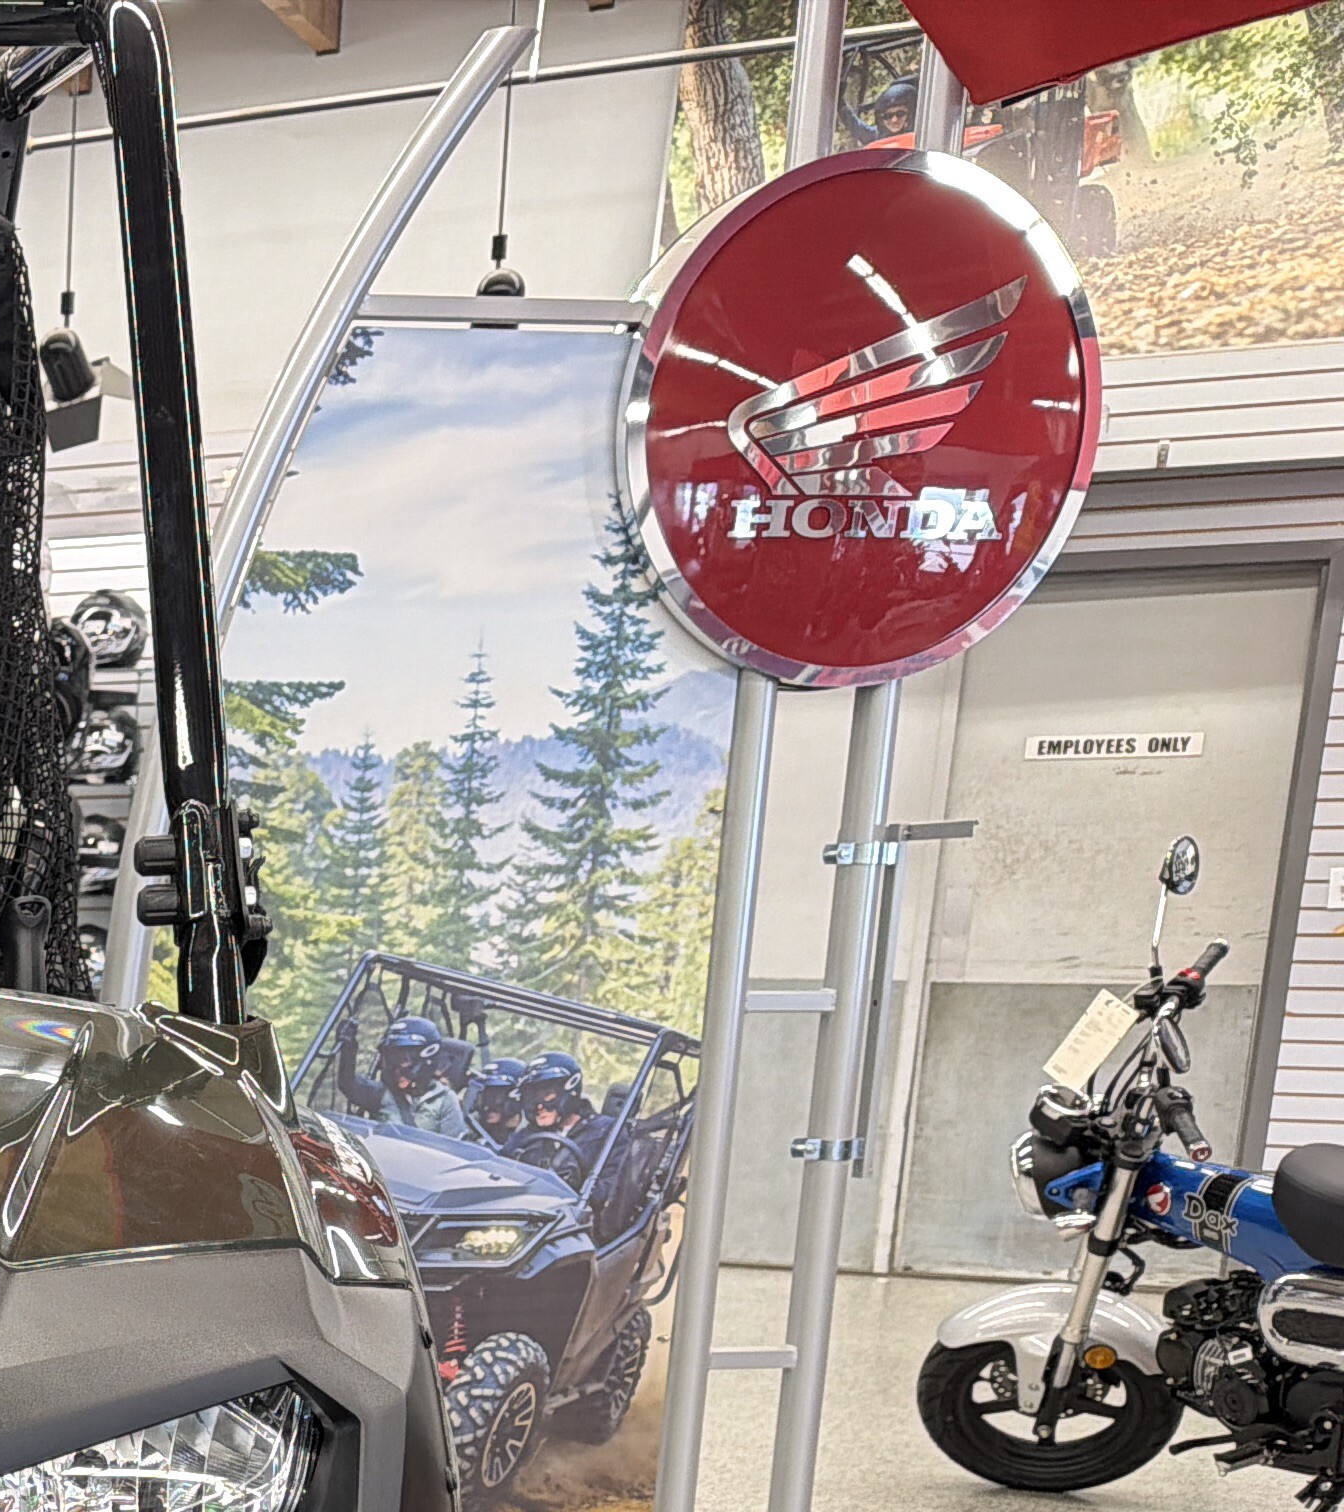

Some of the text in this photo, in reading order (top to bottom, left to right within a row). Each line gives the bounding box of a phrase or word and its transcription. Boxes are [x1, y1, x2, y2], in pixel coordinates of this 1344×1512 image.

[726, 497, 1004, 541] HONDA
[1036, 736, 1192, 756] EMPLOYEES ONLY
[1182, 1191, 1239, 1238] Dax
